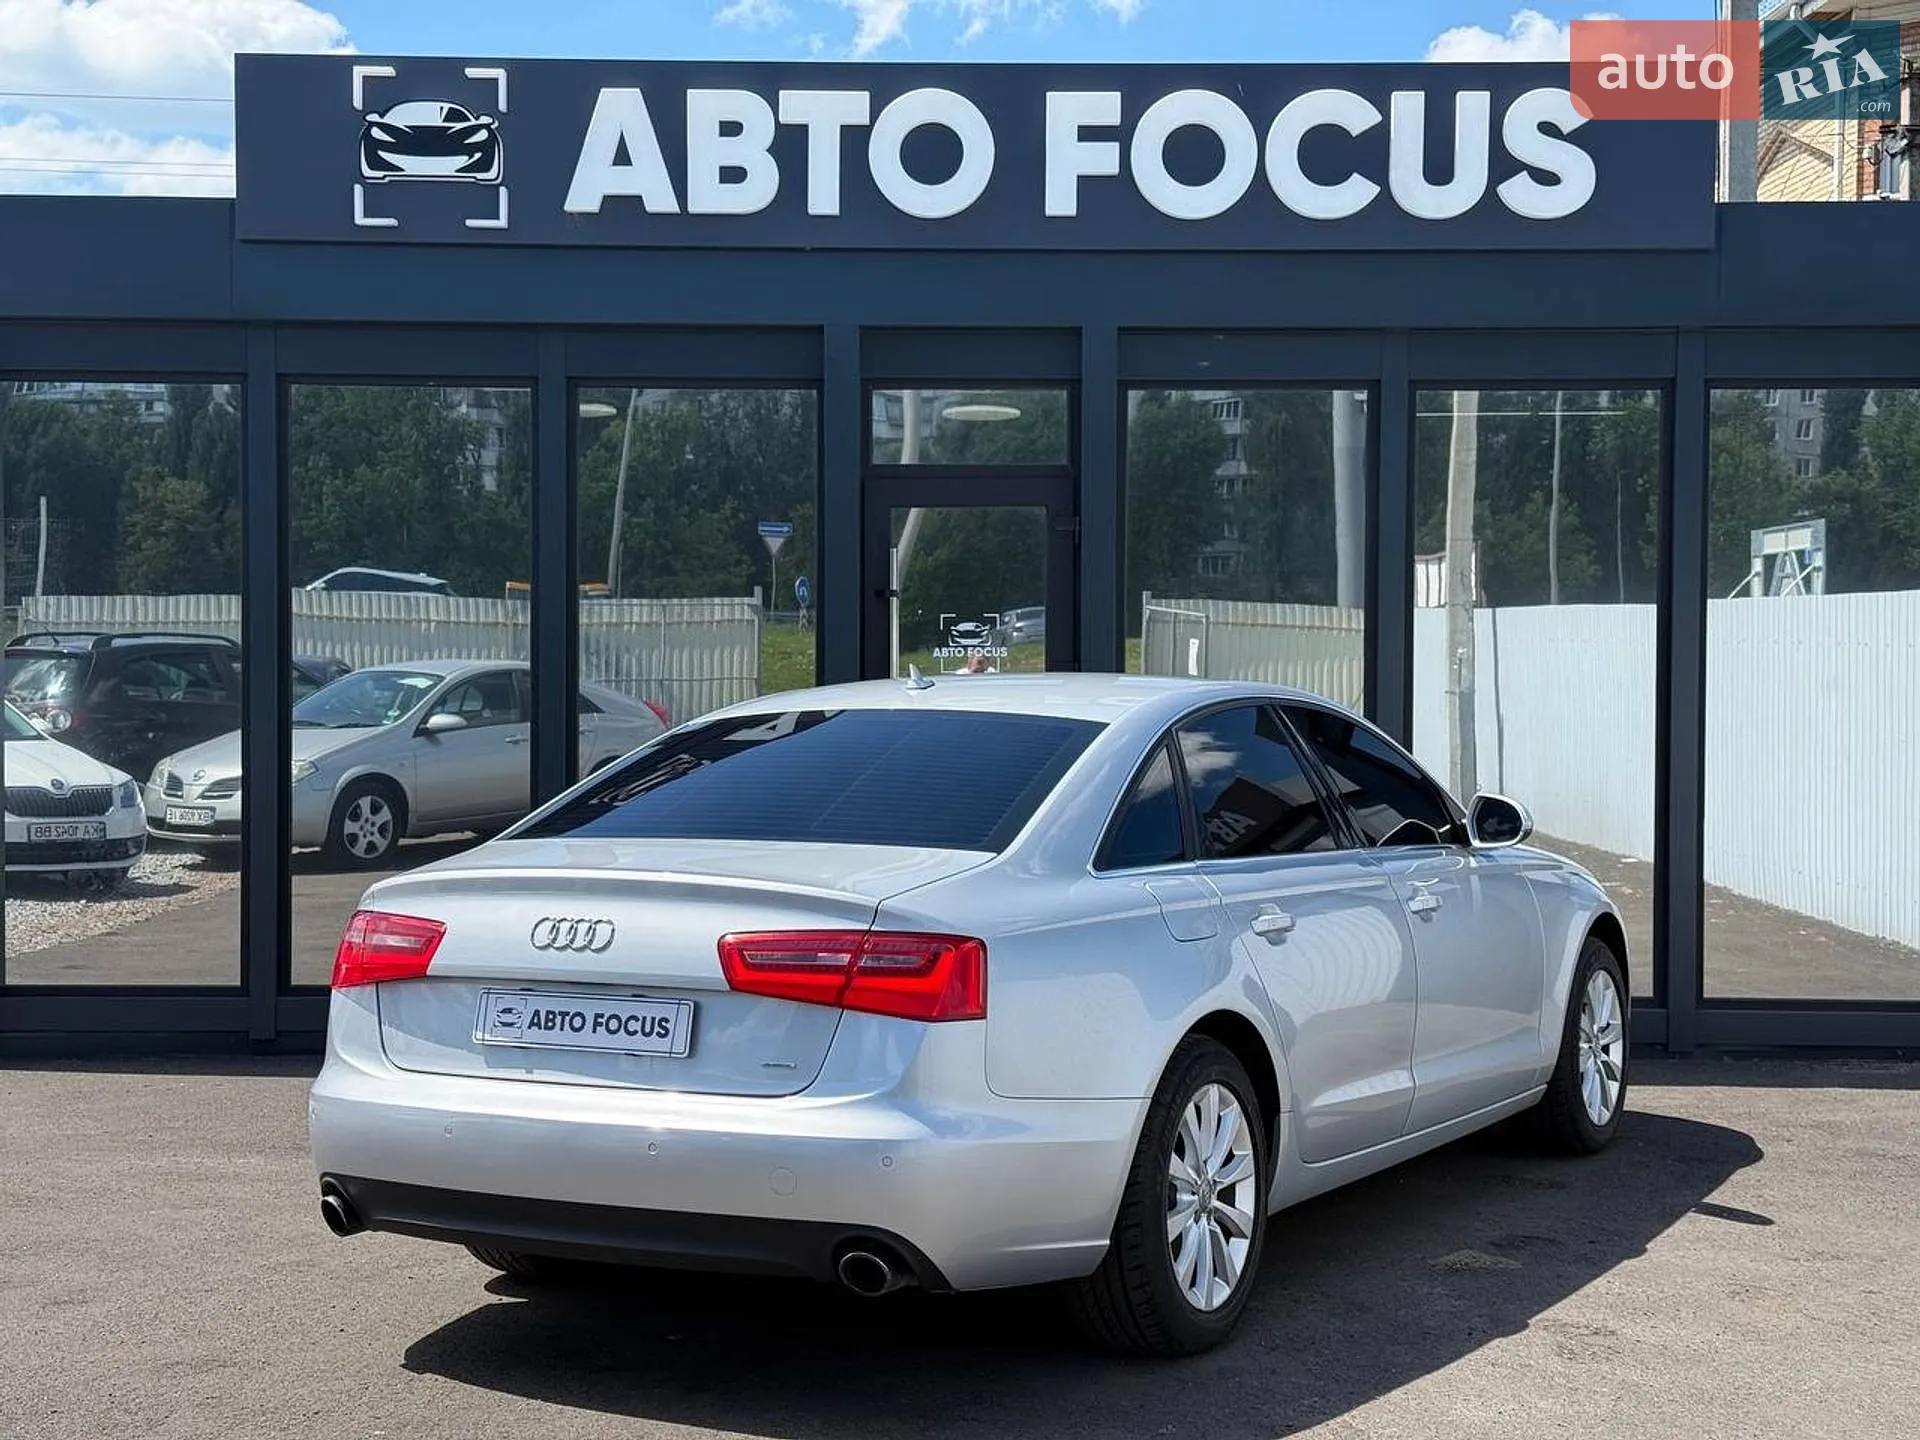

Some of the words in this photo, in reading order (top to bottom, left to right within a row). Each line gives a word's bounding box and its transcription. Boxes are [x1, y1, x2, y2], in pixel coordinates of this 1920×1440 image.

[564, 87, 996, 219] АВТО
[1045, 87, 1597, 220] FOCUS
[933, 647, 965, 657] АВТО
[967, 647, 1008, 657] FOCUS
[527, 1009, 586, 1033] АВТО
[592, 1012, 670, 1039] FOCUS
